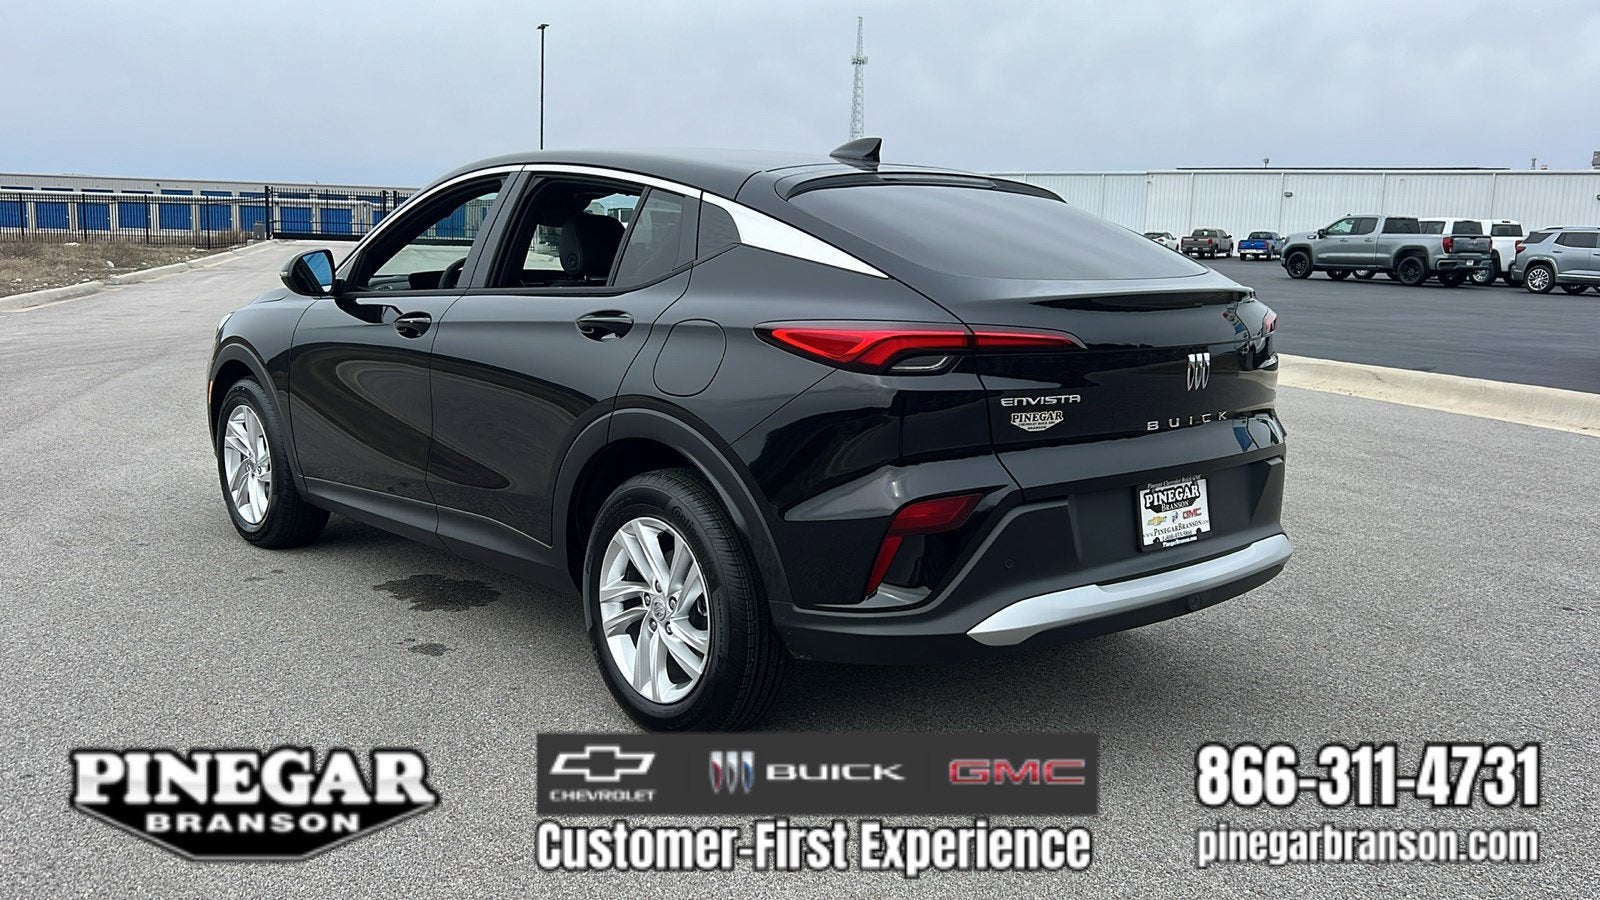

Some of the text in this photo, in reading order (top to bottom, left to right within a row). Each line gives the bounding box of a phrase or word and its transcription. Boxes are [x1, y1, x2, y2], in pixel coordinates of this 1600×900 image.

[1001, 395, 1081, 407] ENVISTA
[1011, 411, 1063, 423] PINEGAR
[1147, 411, 1227, 431] BUICK
[1145, 485, 1200, 508] PINEGAR
[1161, 500, 1189, 511] BRANSON
[1182, 508, 1202, 519] GMC
